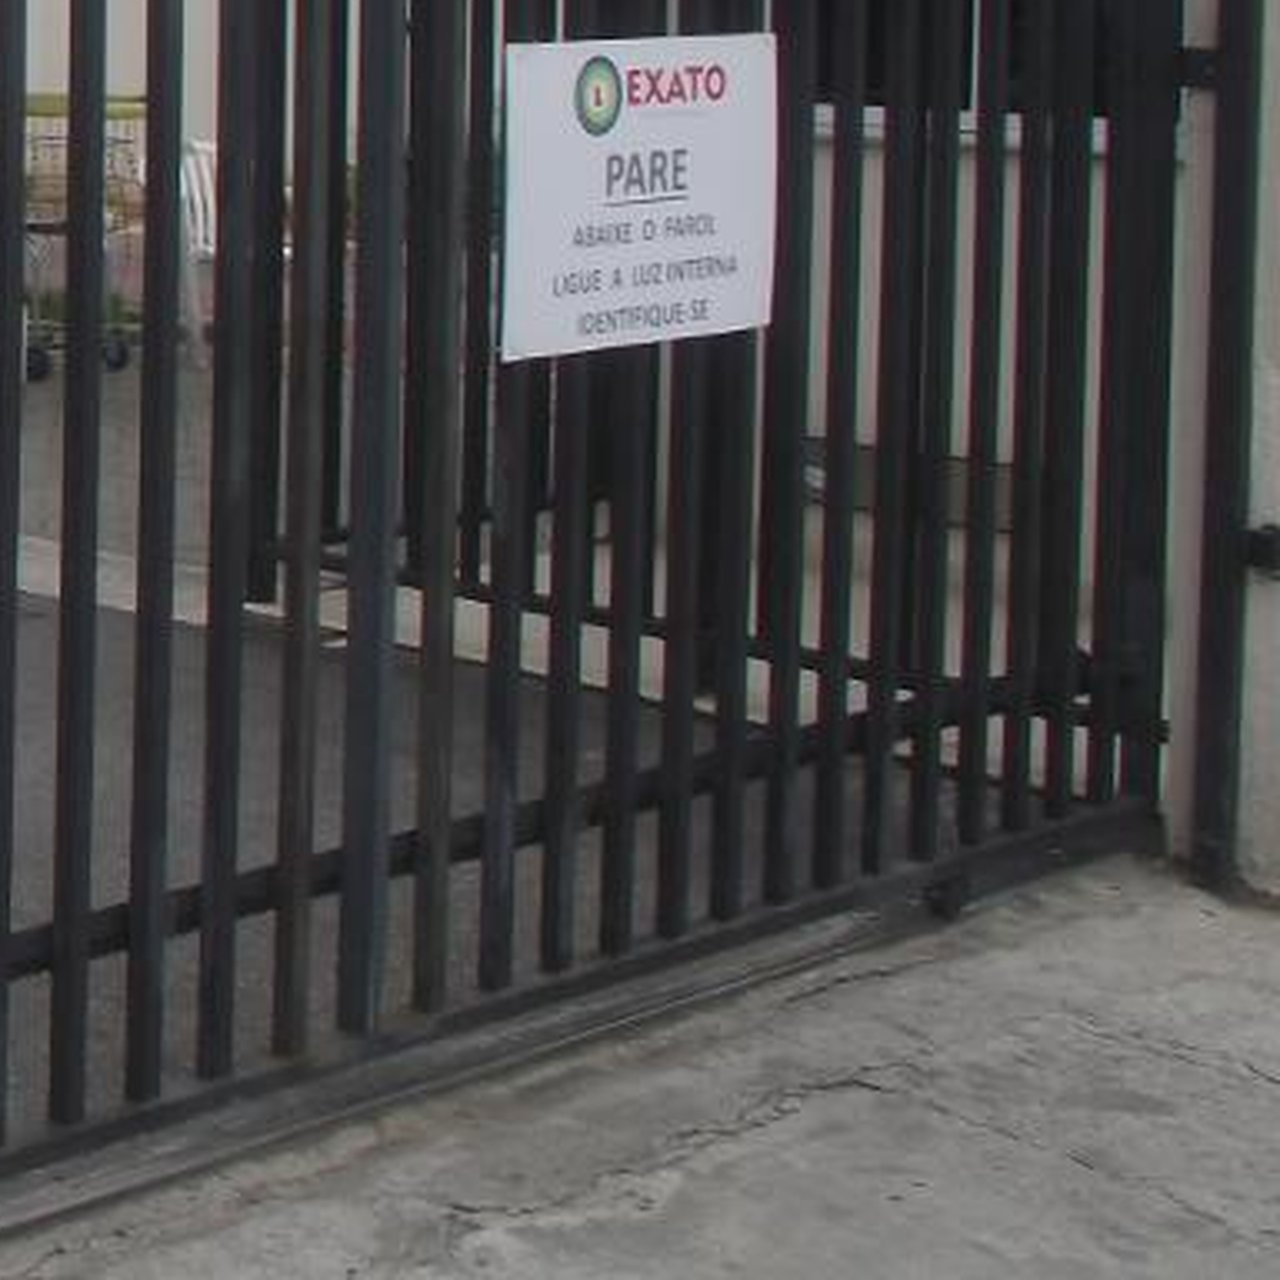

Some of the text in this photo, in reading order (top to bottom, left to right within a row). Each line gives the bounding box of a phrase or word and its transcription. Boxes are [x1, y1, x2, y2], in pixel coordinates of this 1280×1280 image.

[626, 64, 727, 107] EXATO
[604, 148, 689, 197] PARE
[573, 222, 633, 247] ABAIXE
[642, 219, 656, 241] O
[552, 255, 738, 297] LIGUE A LUZ INTERNA
